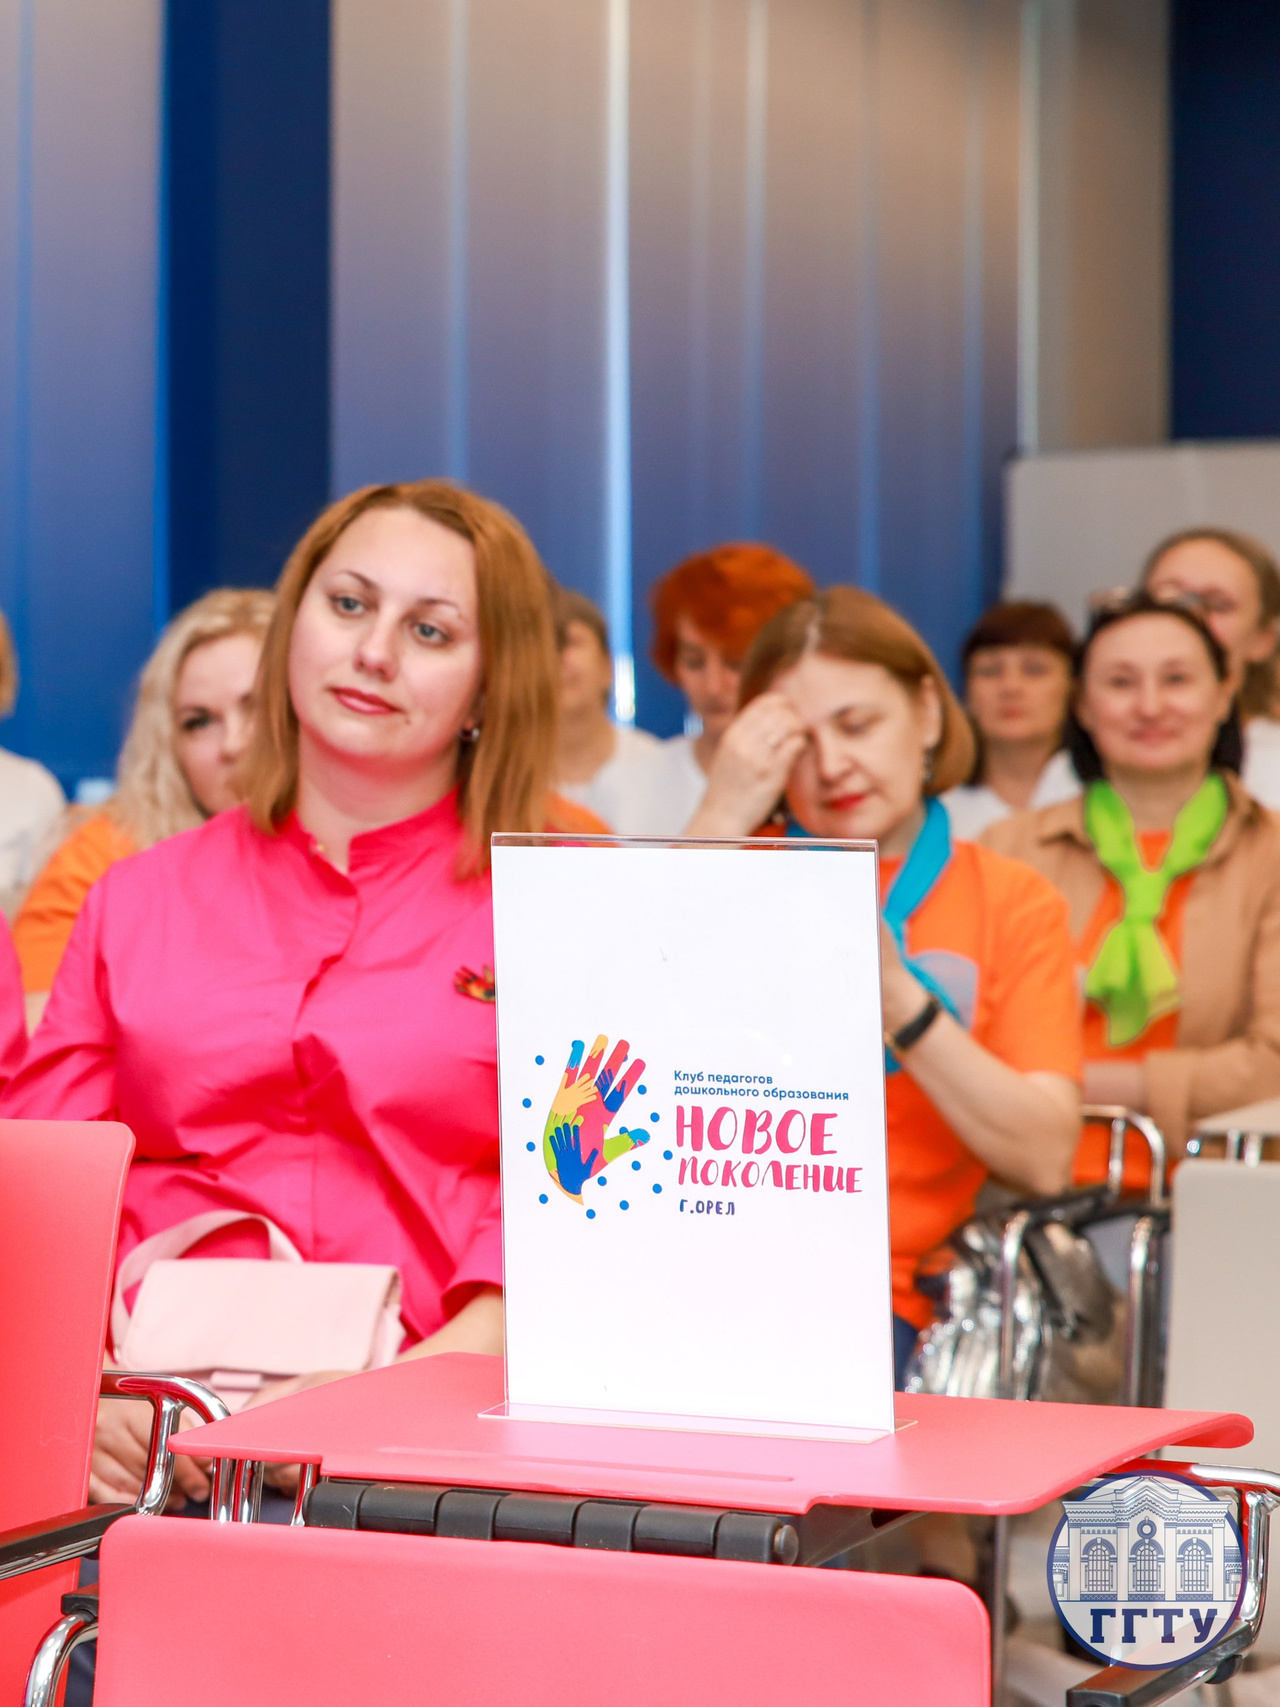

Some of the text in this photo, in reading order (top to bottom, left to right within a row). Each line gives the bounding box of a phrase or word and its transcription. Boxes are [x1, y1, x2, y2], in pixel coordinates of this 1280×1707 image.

[674, 1070, 772, 1084] Клуб педагогов
[674, 1086, 848, 1100] дошкольного образования
[676, 1105, 838, 1155] НОВОЕ
